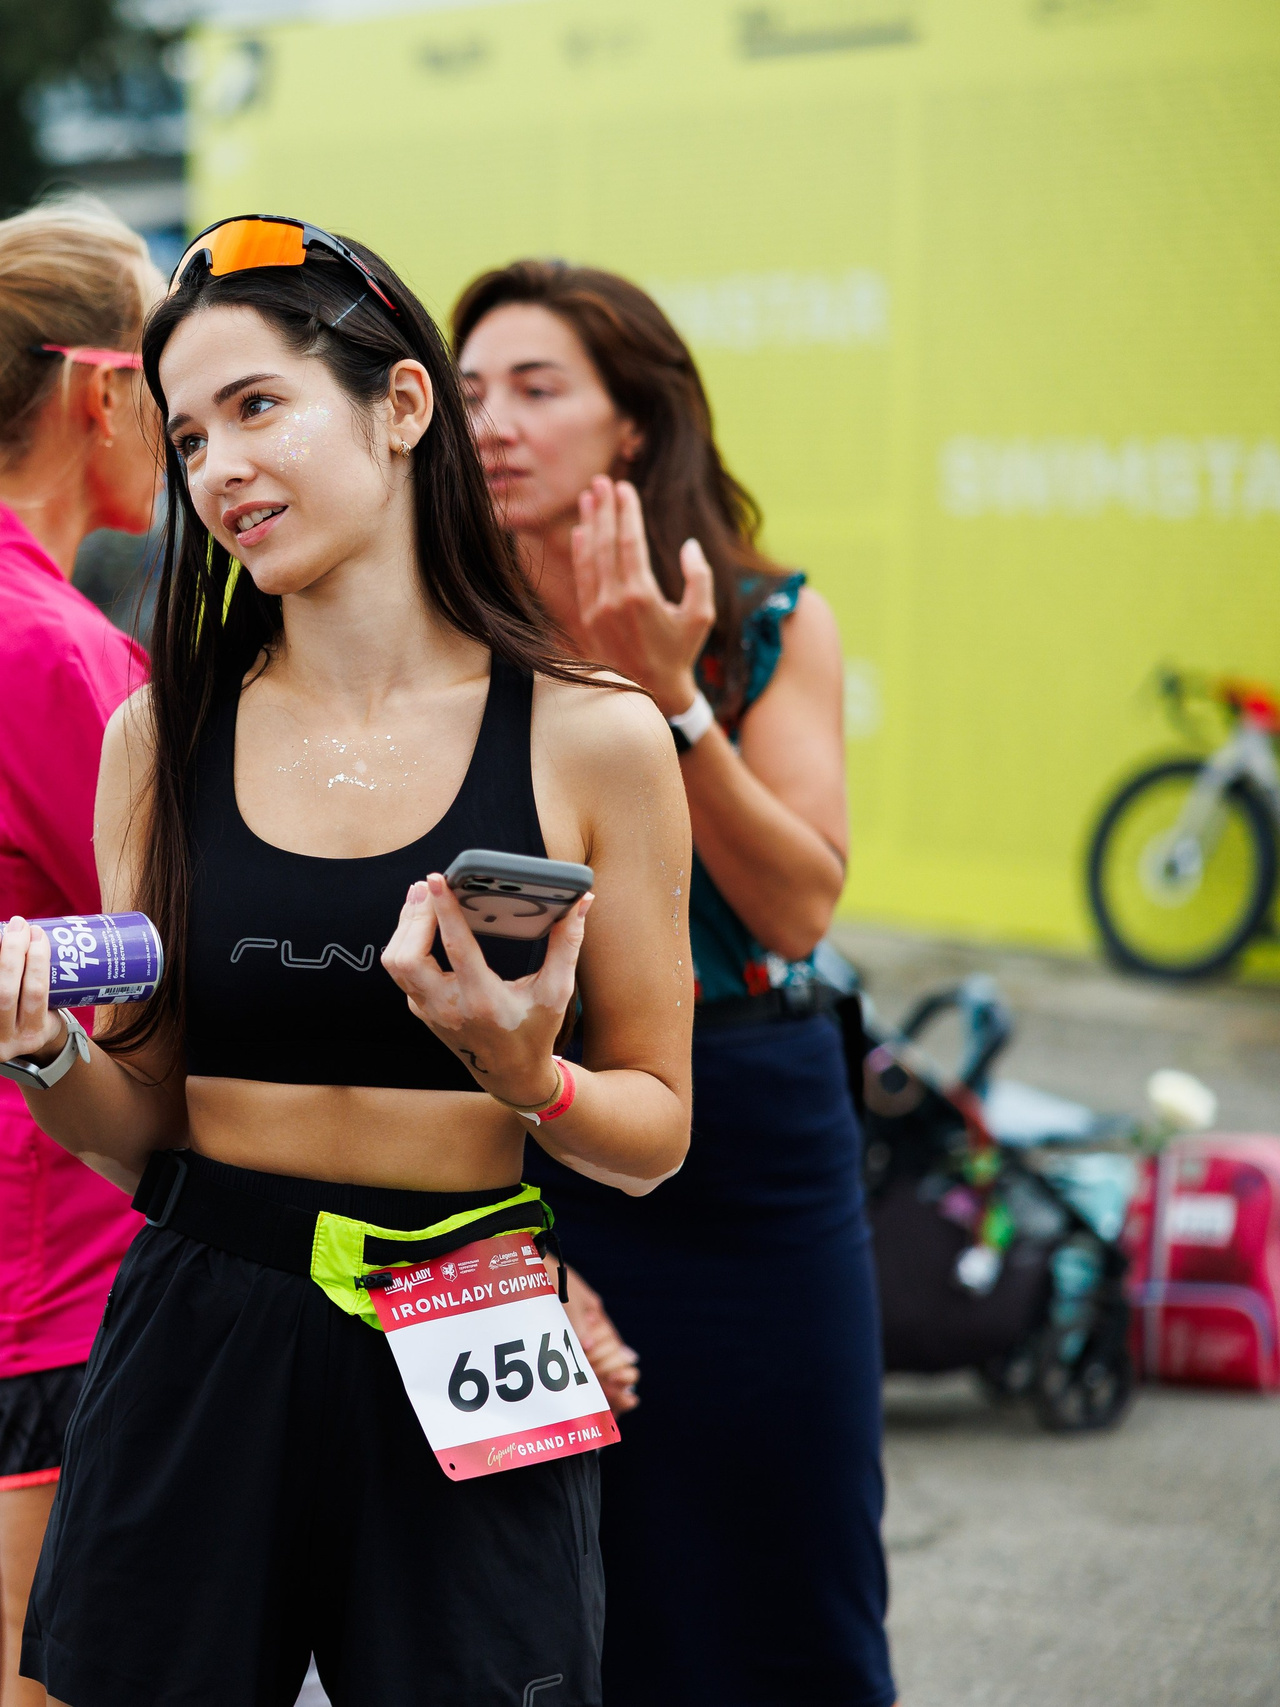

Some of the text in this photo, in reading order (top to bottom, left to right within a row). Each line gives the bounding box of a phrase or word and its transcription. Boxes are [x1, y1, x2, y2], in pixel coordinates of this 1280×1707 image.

[52, 927, 80, 982] ИЗО
[391, 1283, 493, 1321] IRONLADY
[498, 1272, 547, 1295] СИРИУС
[410, 1267, 432, 1283] LADY
[448, 1328, 588, 1413] 6561
[517, 1435, 564, 1456] GRAND
[567, 1425, 602, 1445] FINAL
